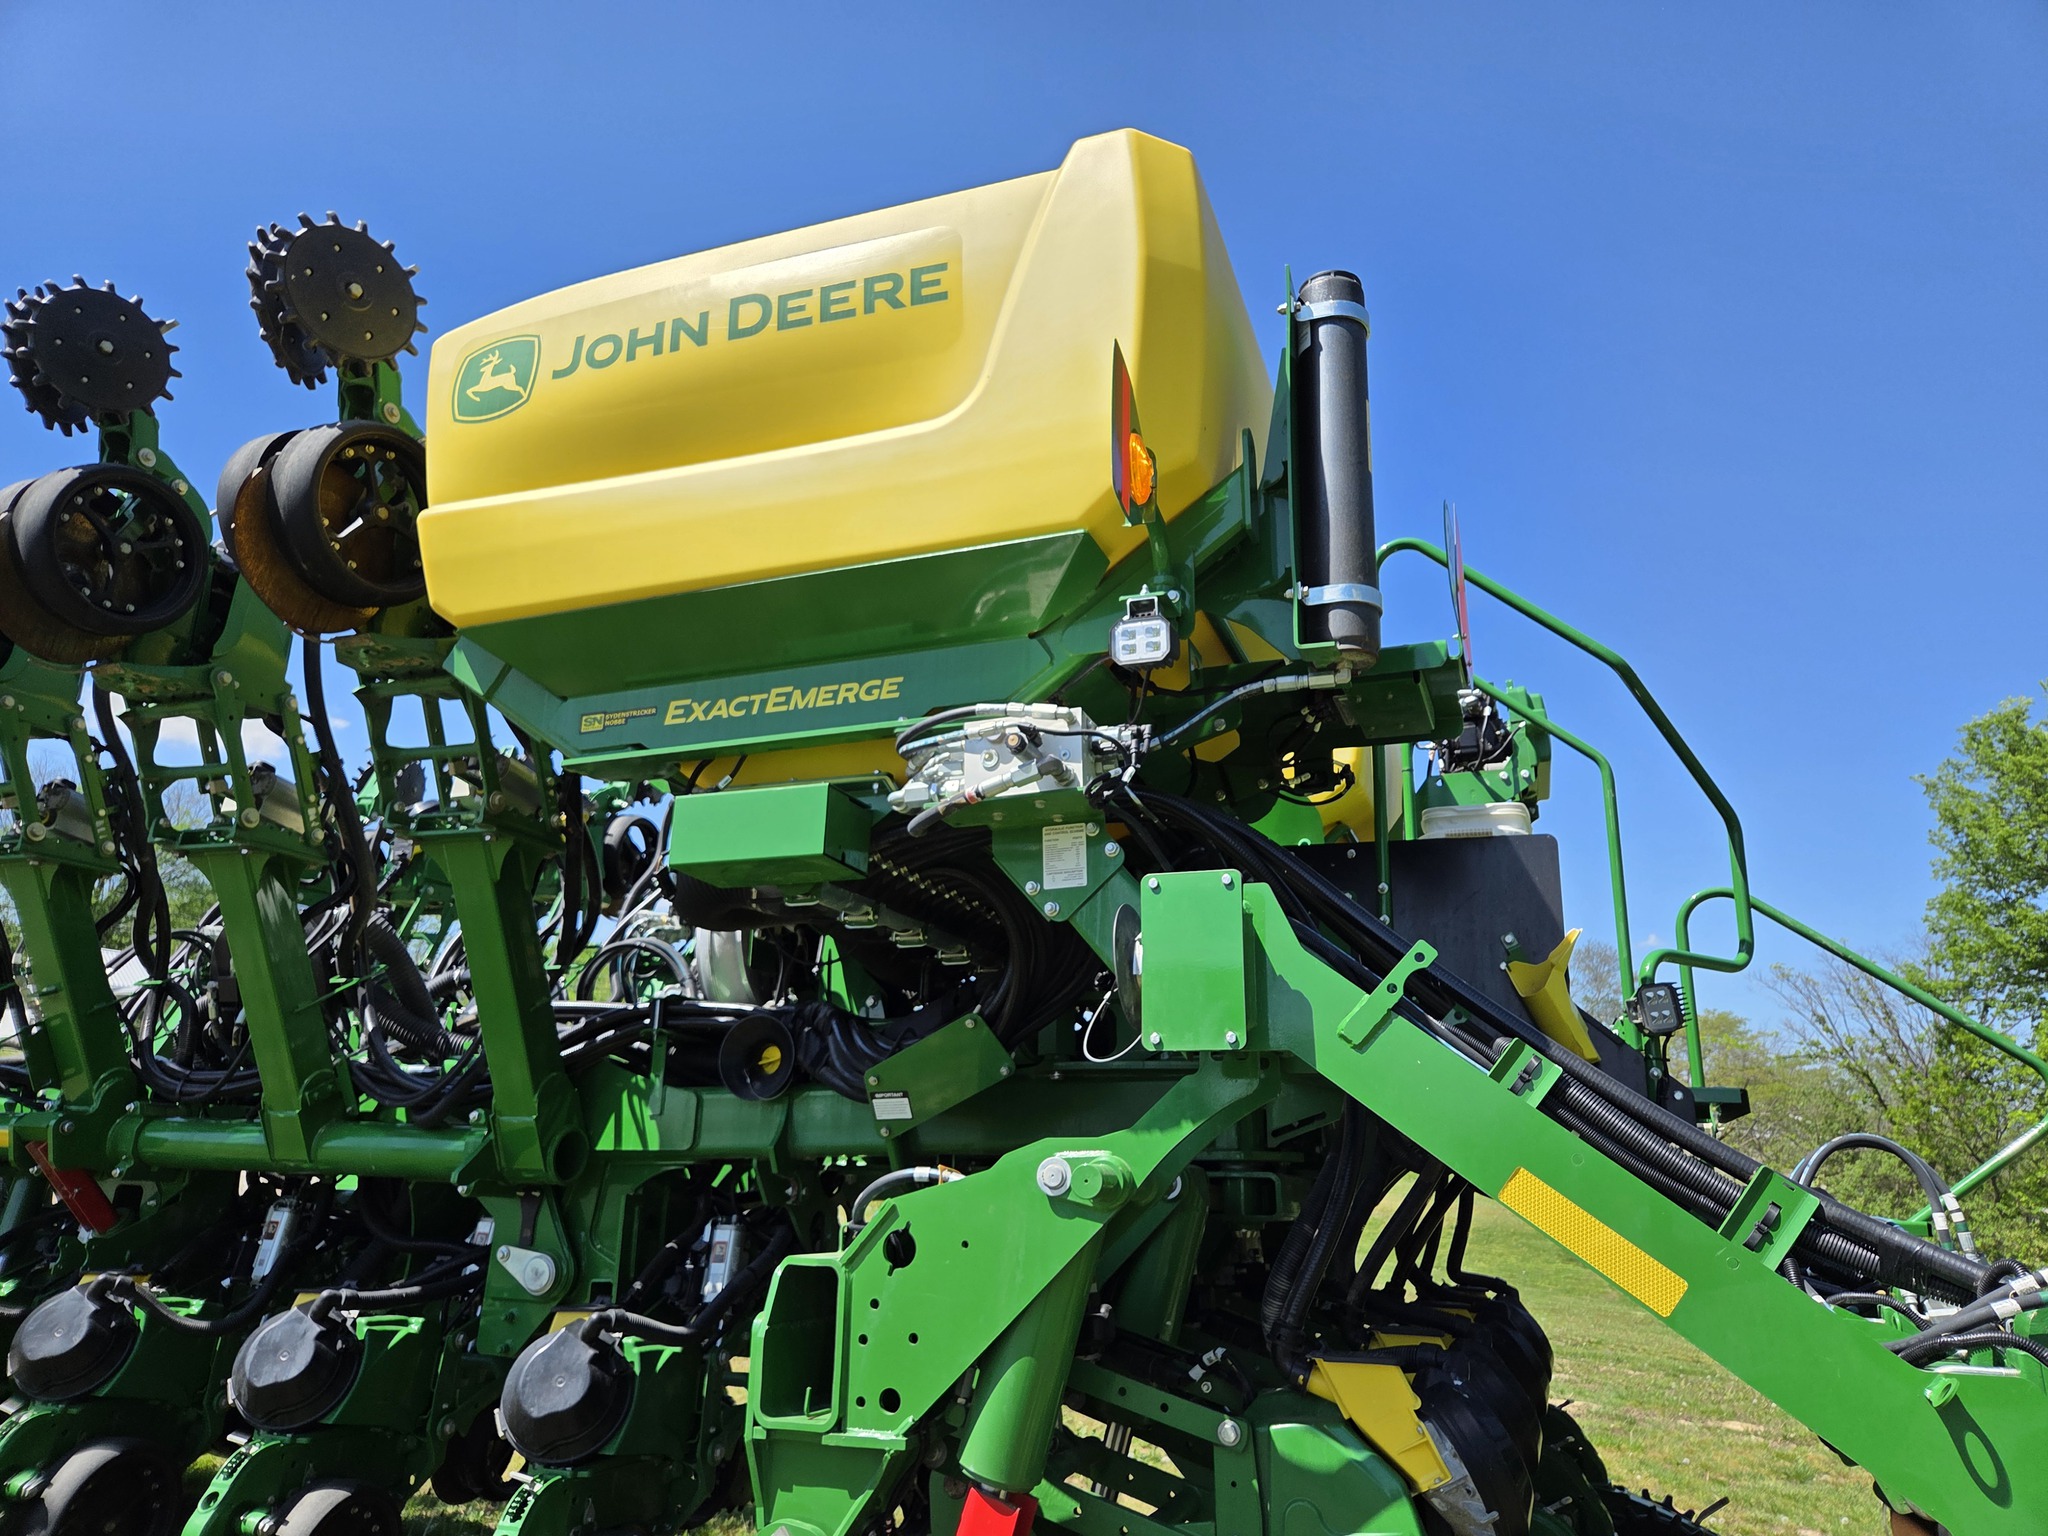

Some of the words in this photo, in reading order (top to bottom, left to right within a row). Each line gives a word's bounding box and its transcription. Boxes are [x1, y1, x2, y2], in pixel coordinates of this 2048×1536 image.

[551, 310, 710, 380] JOHN
[727, 262, 949, 342] DEERE
[584, 716, 603, 727] SN
